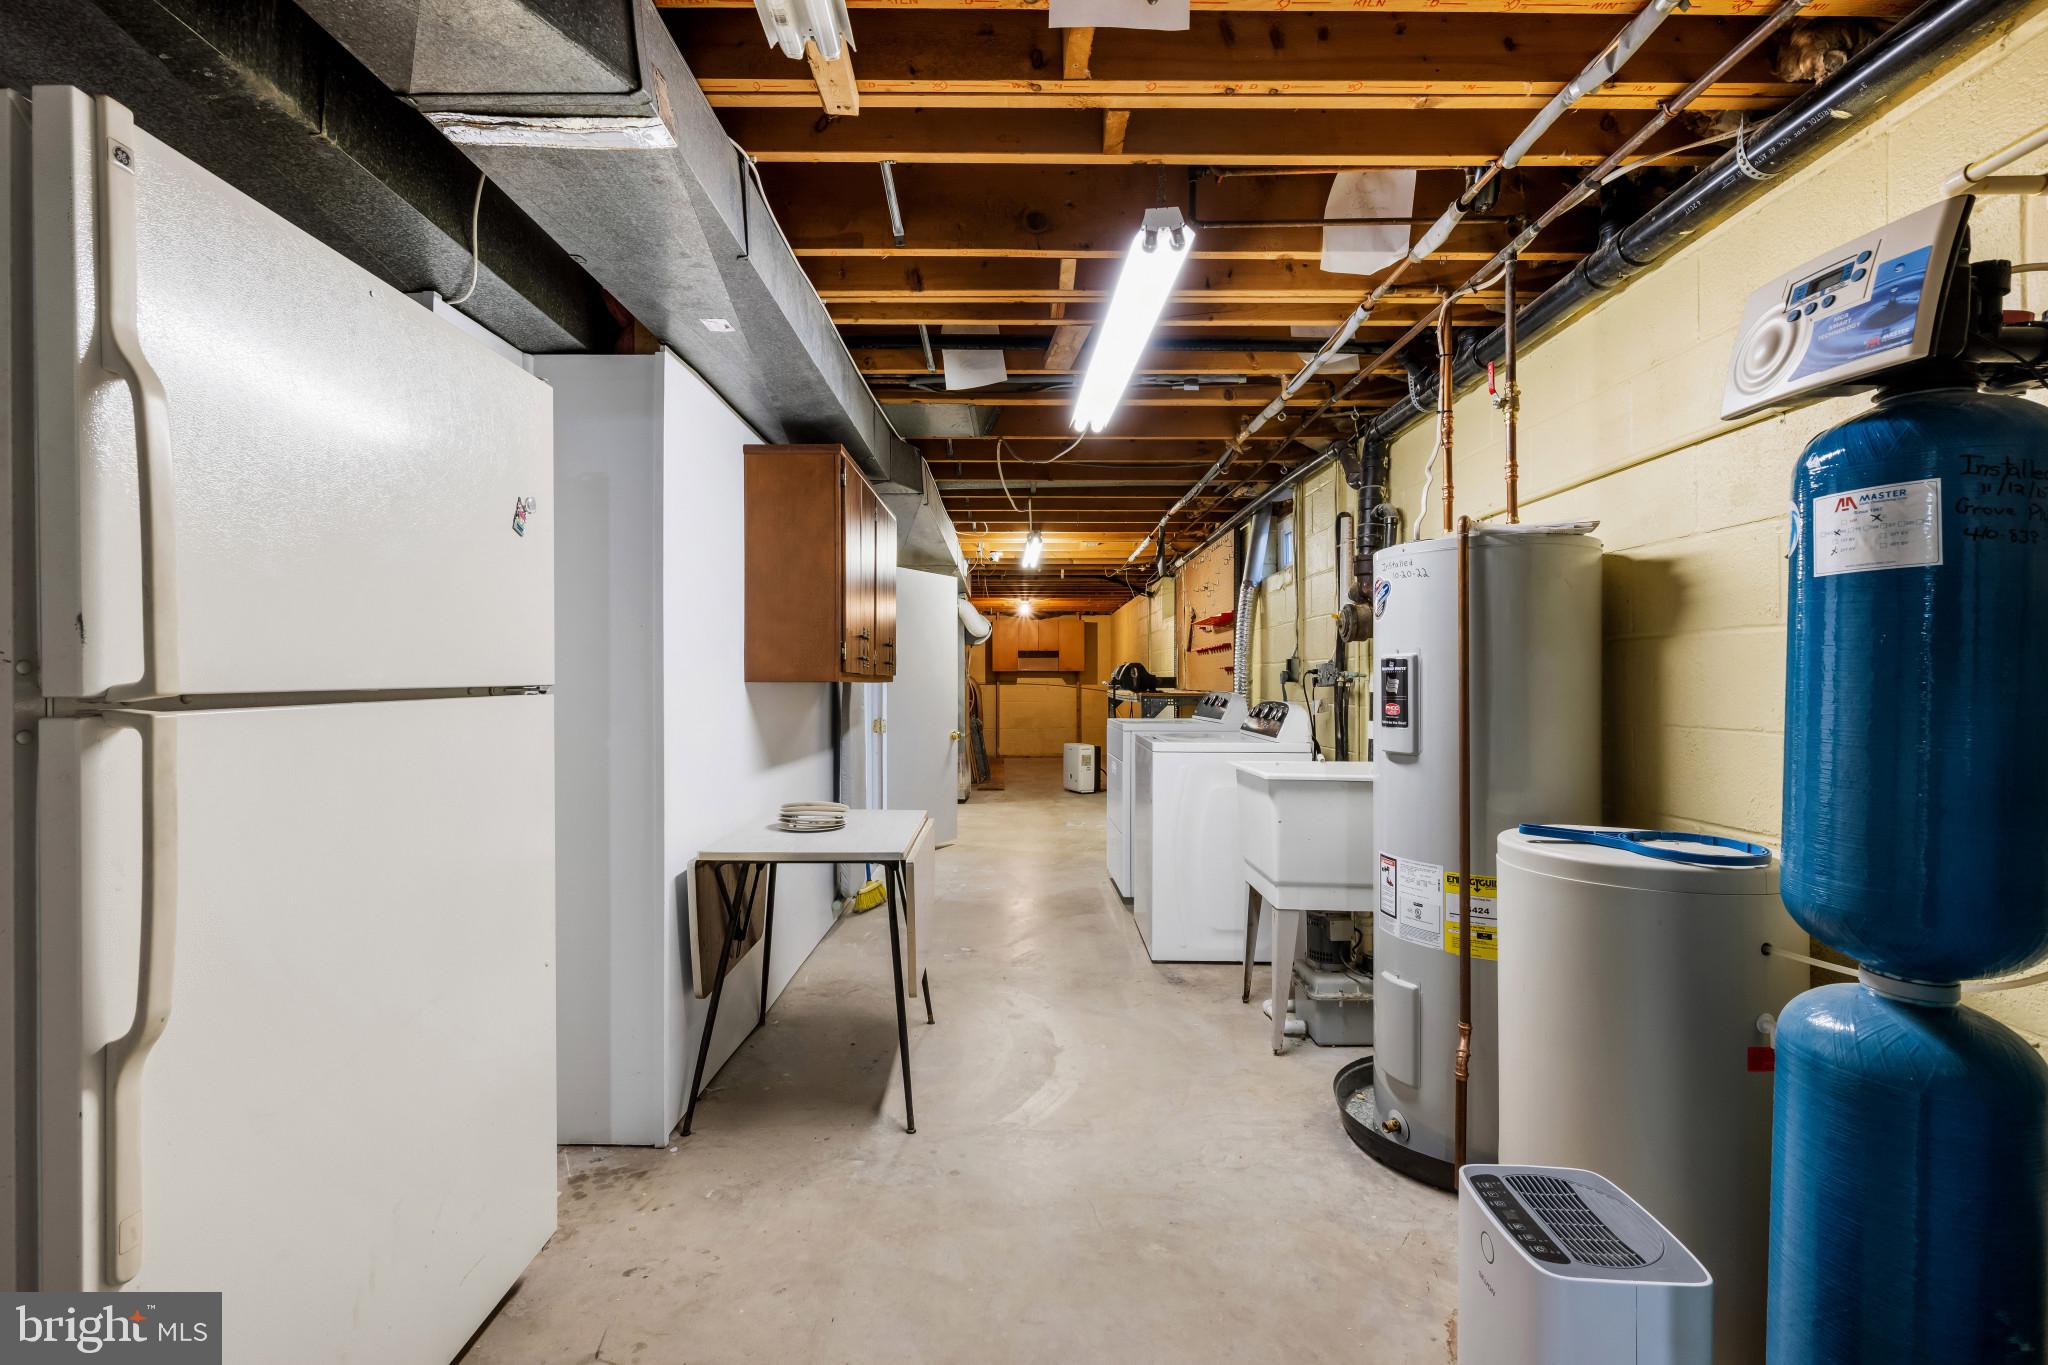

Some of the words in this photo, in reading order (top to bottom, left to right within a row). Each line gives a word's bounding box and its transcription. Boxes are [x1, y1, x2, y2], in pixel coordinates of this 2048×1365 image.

[1860, 489, 1906, 502] MASTER
[1955, 497, 2017, 516] Grove
[1470, 906, 1490, 915] 424
